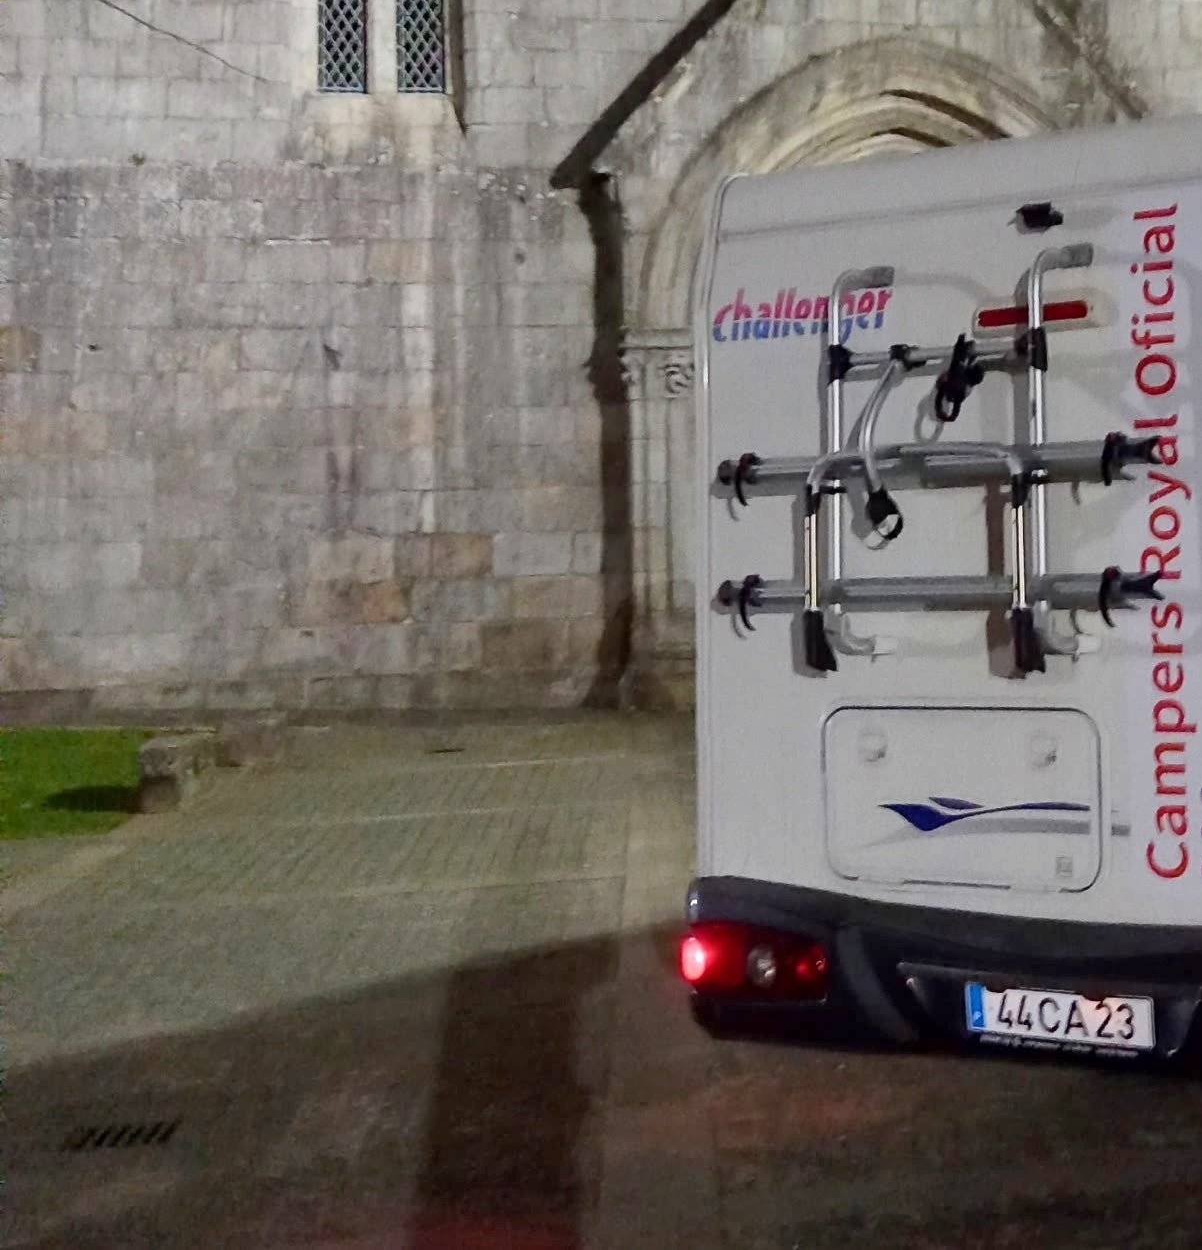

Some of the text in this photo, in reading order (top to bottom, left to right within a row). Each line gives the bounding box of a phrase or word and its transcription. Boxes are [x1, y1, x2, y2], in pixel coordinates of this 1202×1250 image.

[713, 287, 893, 344] challenger
[1130, 202, 1197, 878] Campers Royal Oficial
